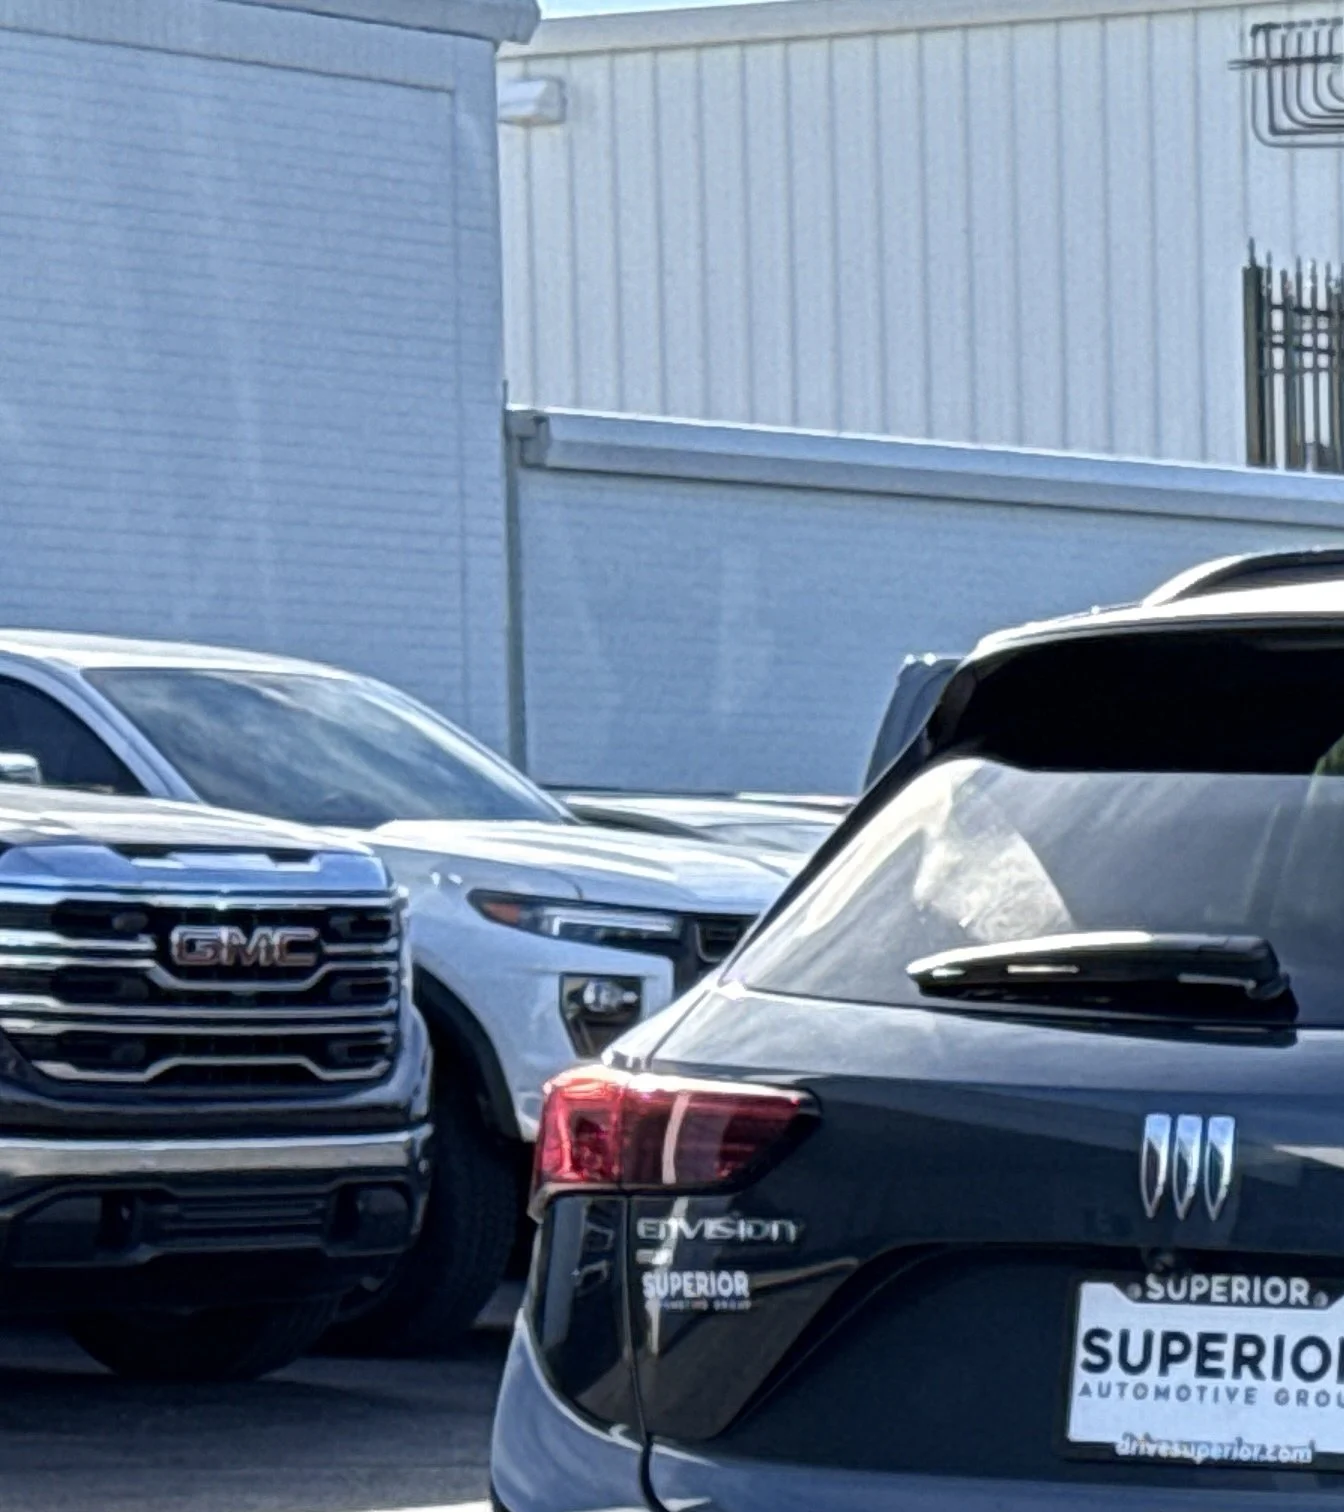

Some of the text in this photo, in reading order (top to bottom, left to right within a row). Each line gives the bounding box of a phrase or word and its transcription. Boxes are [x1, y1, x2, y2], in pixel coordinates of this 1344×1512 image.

[169, 925, 319, 967] GMC
[642, 1270, 750, 1298] SUPERIOR
[1145, 1274, 1311, 1306] SUPERIOR
[1078, 1381, 1259, 1406] AUTOMOTIVE
[1114, 1431, 1315, 1465] drivesuperior.com
